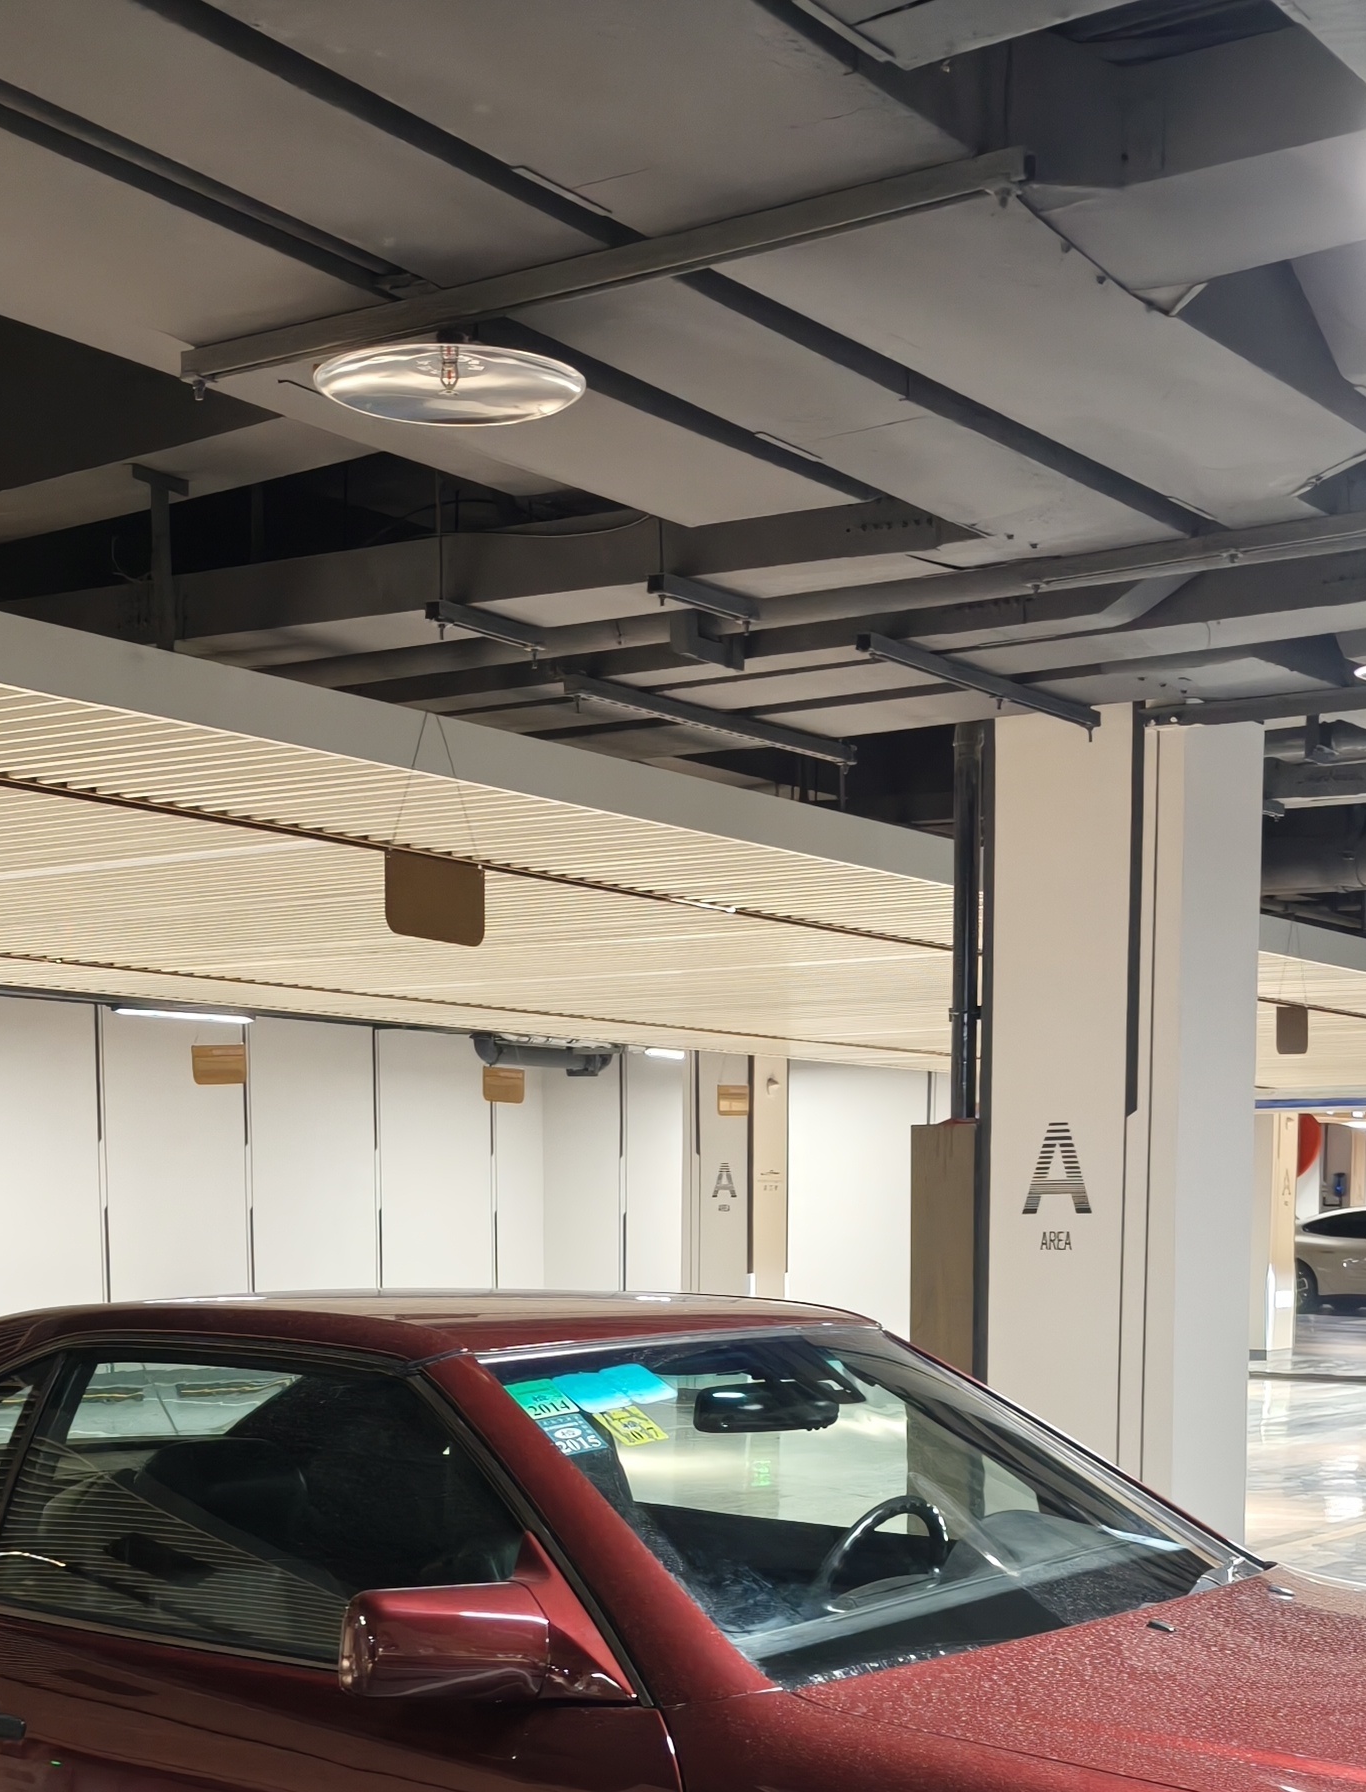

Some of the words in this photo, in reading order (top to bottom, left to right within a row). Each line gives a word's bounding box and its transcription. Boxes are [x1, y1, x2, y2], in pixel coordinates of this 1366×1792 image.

[1022, 1122, 1092, 1214] A
[712, 1162, 737, 1198] A
[1040, 1231, 1073, 1250] AREA
[527, 1401, 570, 1416] 2014
[555, 1435, 603, 1453] 2015
